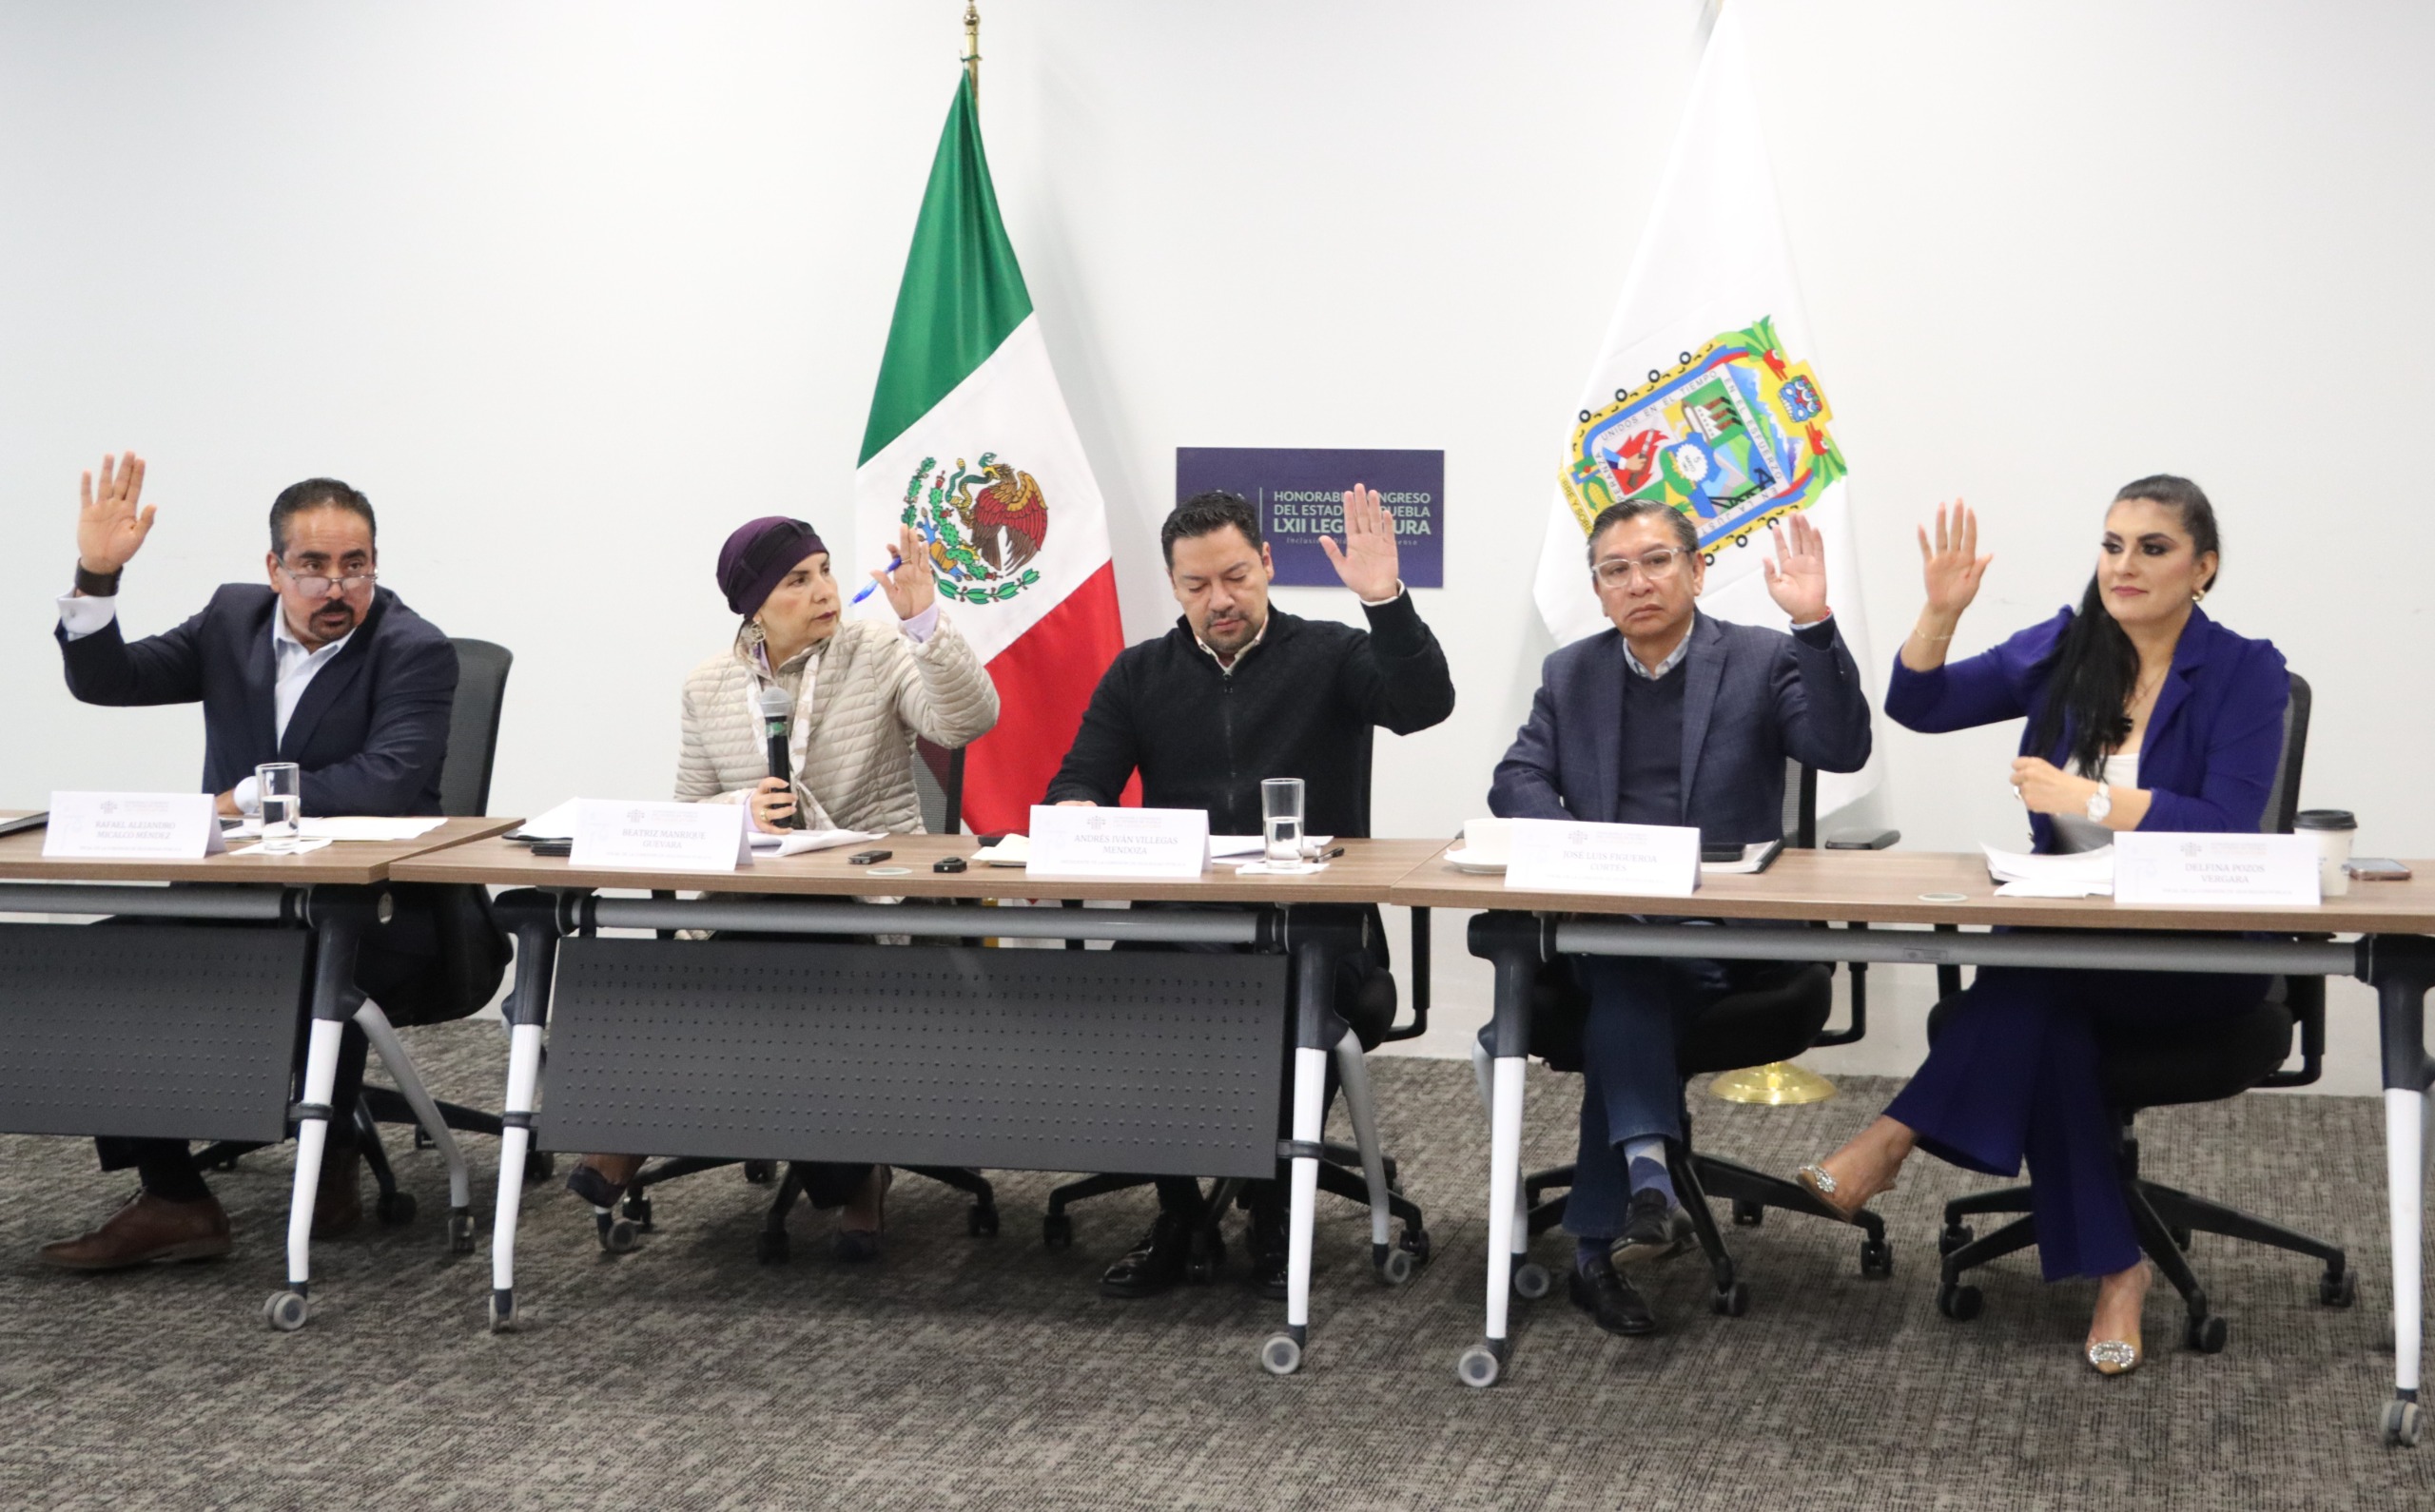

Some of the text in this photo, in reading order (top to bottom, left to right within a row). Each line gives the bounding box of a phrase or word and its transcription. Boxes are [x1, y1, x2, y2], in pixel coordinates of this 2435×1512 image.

[1601, 371, 1718, 441] UNIDOS EN EL TIEMPO
[1724, 378, 1782, 479] EN EL ESFUERZO
[1596, 453, 1626, 501] PERANZA
[1275, 491, 1432, 504] HONORABL NGRESO
[1275, 504, 1298, 515] DEL
[1301, 505, 1344, 515] ESTAD
[1701, 487, 1779, 535] EN LA JUST
[1274, 518, 1432, 534] LXII LEGURA
[1575, 508, 1594, 533] SOBE
[95, 821, 127, 829] RAFAEL
[622, 828, 707, 841] BEATRIZ MANRIQUE
[1074, 833, 1179, 844] ANDRÉS IVÁN VILLEGAS
[642, 841, 683, 849] GUEVARA
[1102, 845, 1147, 855] MENDOZA
[1562, 849, 1658, 863] JOSÉ LUIS FIGUEROA
[1590, 862, 1627, 872] CORTÉS
[2184, 863, 2266, 872] DELFINA POZOS
[2201, 874, 2250, 883] VERGARA
